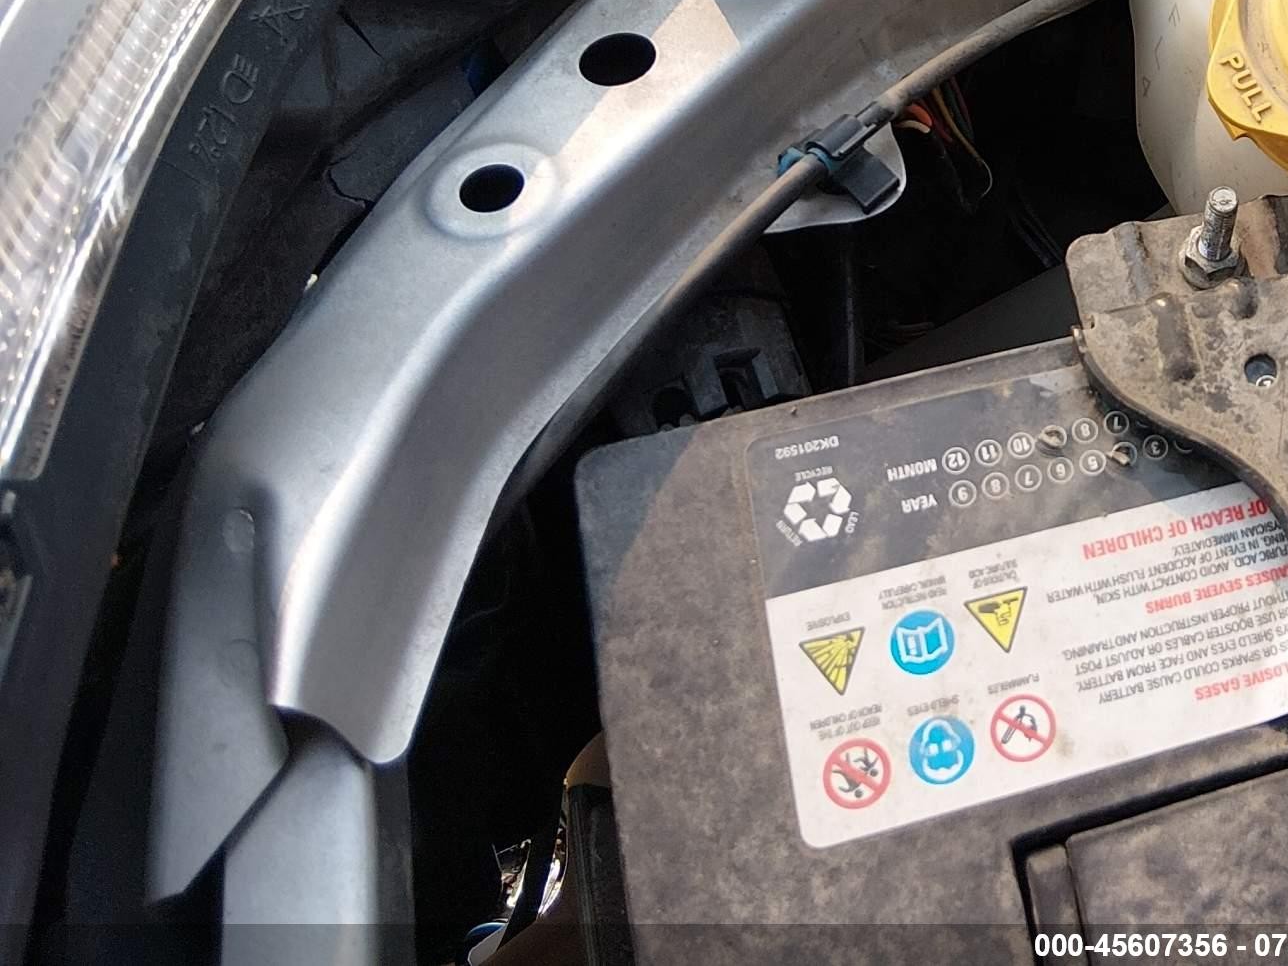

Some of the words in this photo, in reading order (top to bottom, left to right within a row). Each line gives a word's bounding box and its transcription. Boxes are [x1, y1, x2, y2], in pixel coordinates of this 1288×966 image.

[1219, 54, 1272, 123] PULL
[773, 433, 840, 459] DK201592
[793, 464, 833, 482] RECYCLE
[885, 456, 937, 482] MONTH
[900, 492, 938, 513] YEAR
[1245, 497, 1268, 518] OF
[844, 510, 858, 532] LEAD
[1165, 518, 1188, 538] OF
[1190, 503, 1244, 532] REACH
[1081, 524, 1164, 560] CHILDREN
[1170, 529, 1239, 557] IMMEDIATELY.
[1213, 541, 1247, 559] EVENT
[1247, 538, 1260, 550] IN
[1147, 554, 1197, 577] ACCIDENT
[1198, 551, 1212, 563] OF
[1111, 567, 1145, 586] FLUSH
[1198, 559, 1230, 577] AVOID
[1083, 577, 1112, 594] WITH
[1121, 581, 1150, 598] WITH
[1149, 568, 1198, 590] CONTACT
[1192, 576, 1243, 601] SEVERE
[1045, 584, 1082, 604] WATER
[1143, 590, 1192, 614] BURNS
[805, 610, 851, 631] EXPLOSIVE
[1208, 599, 1250, 621] PROPER
[1254, 609, 1277, 626] USE
[1138, 611, 1209, 640] INSTRUCTION
[1204, 615, 1254, 639] BOOSTER
[1060, 636, 1115, 661] TRAINING.
[1113, 630, 1138, 647] AND
[1146, 641, 1163, 655] OR
[1163, 629, 1205, 650] CABLES
[1209, 638, 1236, 656] EYES
[1237, 628, 1274, 649] SHIELD
[1102, 645, 1146, 667] ADJUST
[1158, 652, 1185, 670] FACE
[1185, 645, 1210, 662] AND
[1220, 647, 1262, 669] SPARKS
[1261, 643, 1278, 658] OR
[1072, 657, 1103, 676] POST
[1124, 660, 1157, 679] FROM
[1182, 659, 1220, 680] COULD
[1074, 669, 1124, 692] BATTERY.
[1145, 670, 1182, 690] CAUSE
[1193, 675, 1241, 701] GASES
[928, 693, 961, 711] SHIELD
[1096, 680, 1144, 704] BATTERY
[905, 701, 929, 716] EYES
